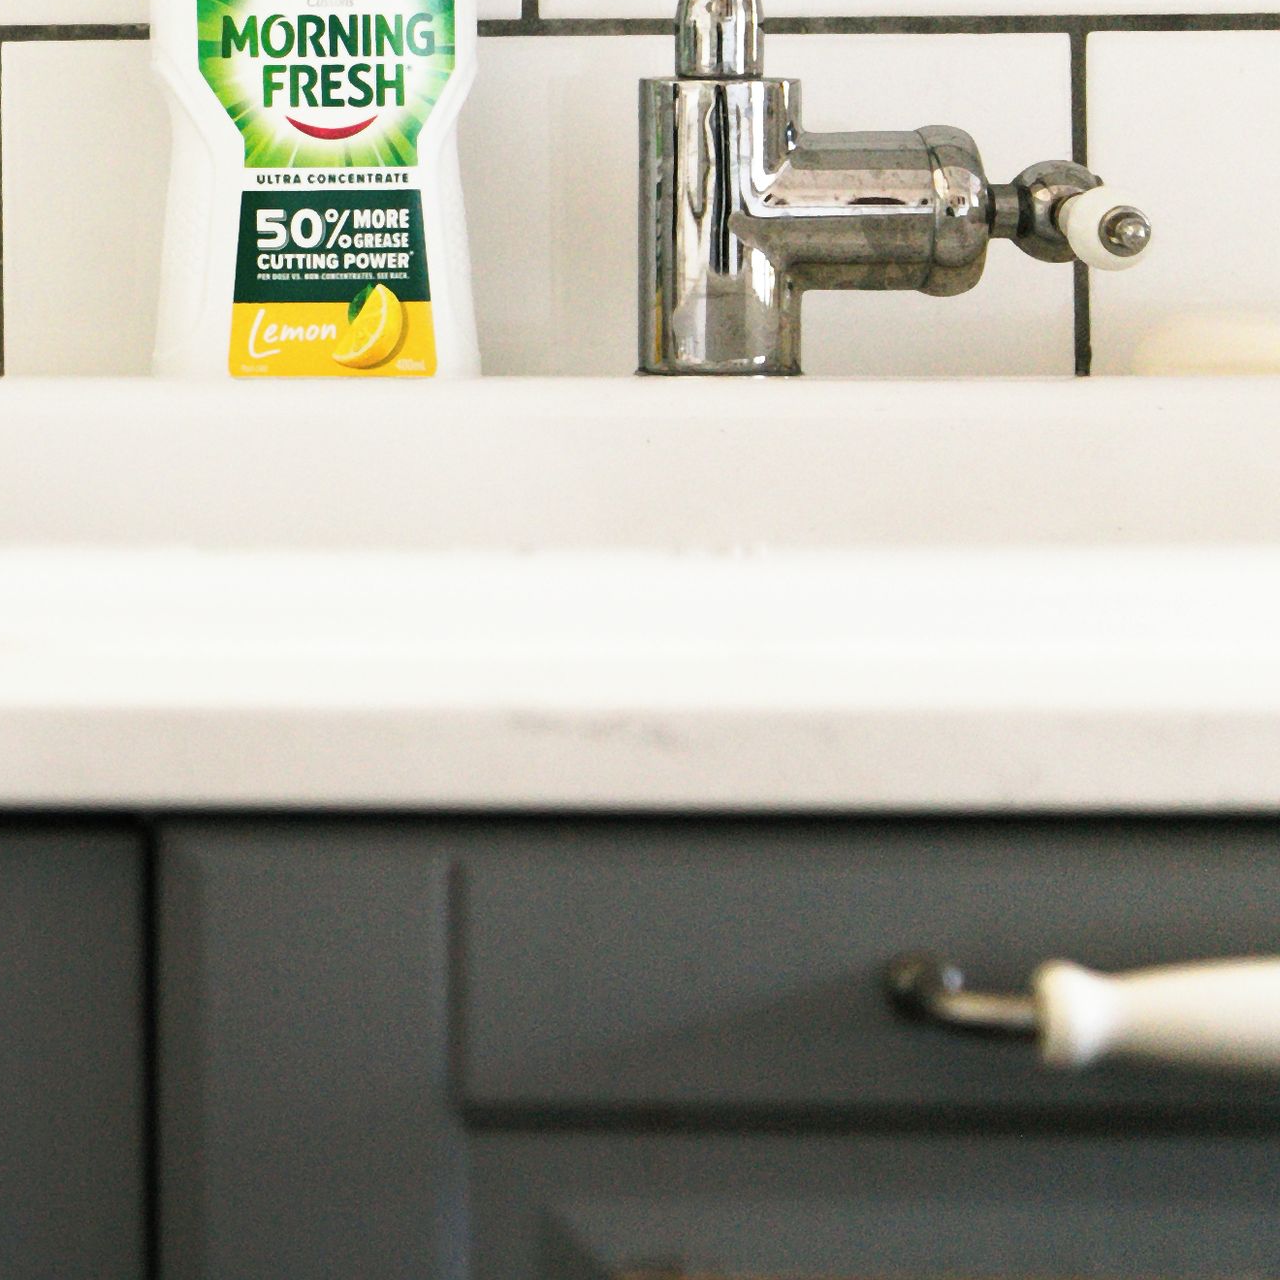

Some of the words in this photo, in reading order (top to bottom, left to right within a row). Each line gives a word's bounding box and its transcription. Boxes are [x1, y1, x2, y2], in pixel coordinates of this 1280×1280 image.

[222, 13, 435, 58] MORNING
[263, 63, 404, 107] FRESH
[257, 174, 301, 184] ULTRA
[307, 173, 409, 184] CONCENTRATE
[256, 208, 352, 250] 50%
[353, 209, 410, 229] MORE
[353, 233, 410, 248] GREASE
[257, 254, 339, 270] CUTTING
[256, 272, 271, 280] PER
[248, 308, 337, 359] Lemon
